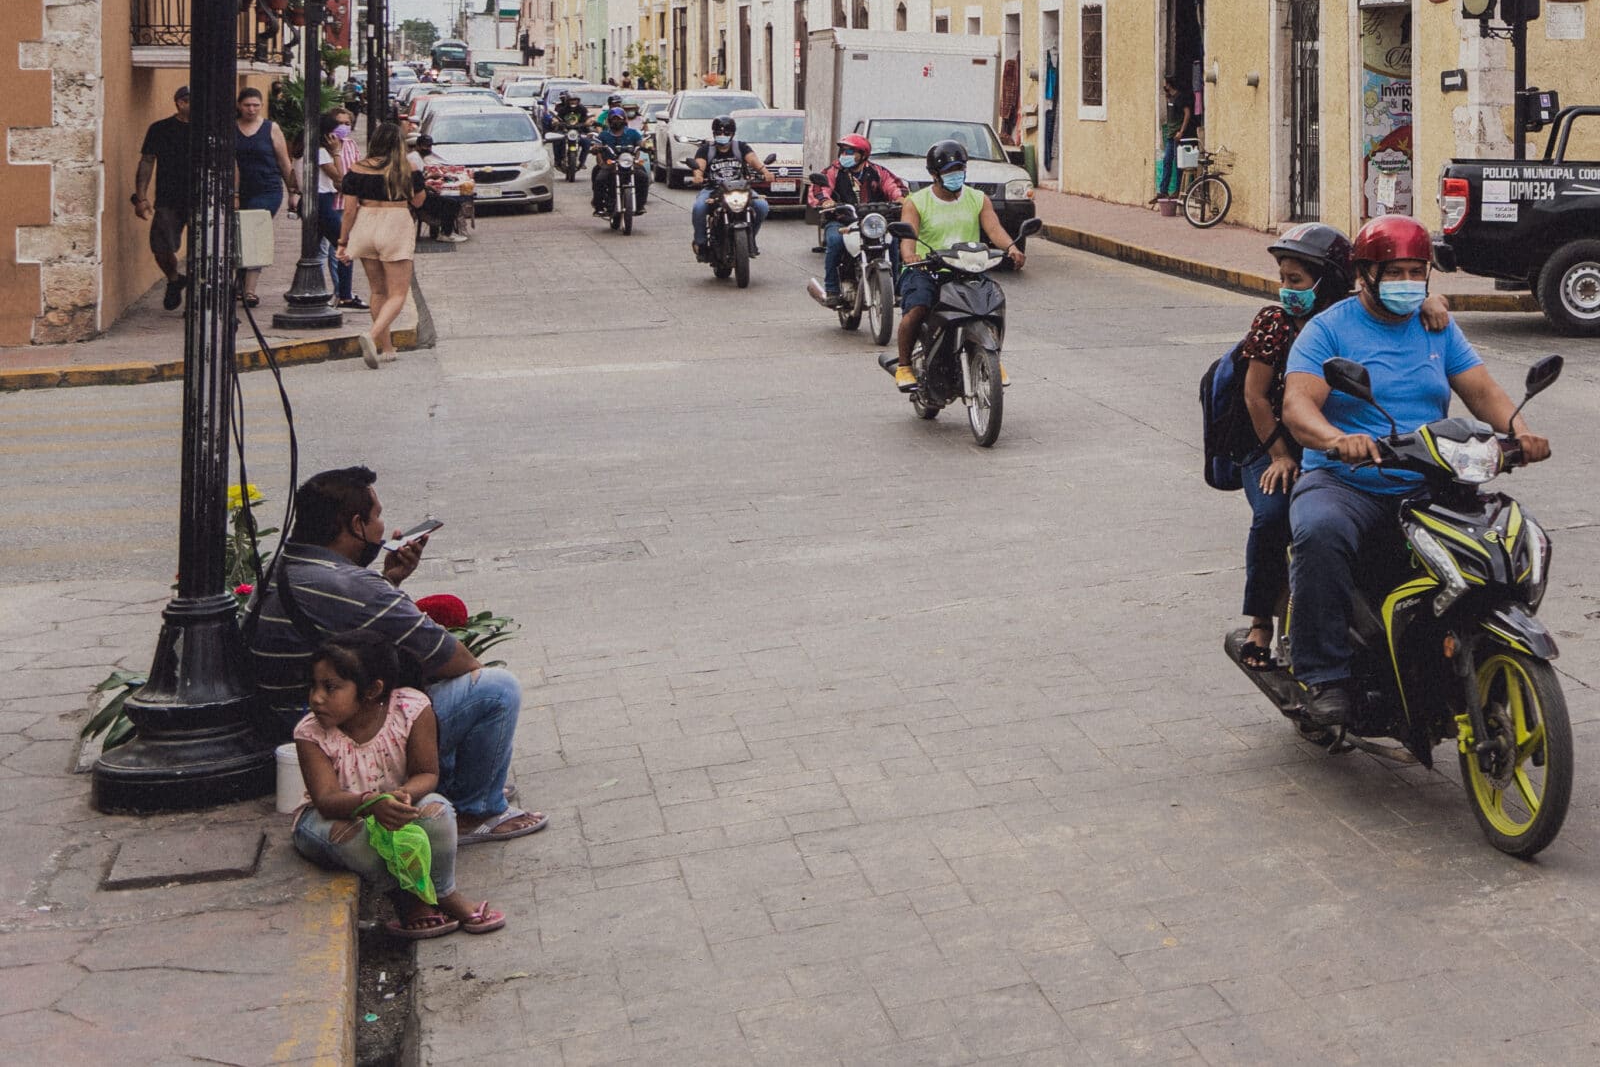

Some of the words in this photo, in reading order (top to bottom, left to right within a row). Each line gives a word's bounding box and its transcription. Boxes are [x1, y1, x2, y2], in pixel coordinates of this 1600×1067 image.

[1483, 168, 1519, 178] POLICIA
[1523, 168, 1575, 179] MUNICIPAL
[1511, 182, 1555, 200] DPM334
